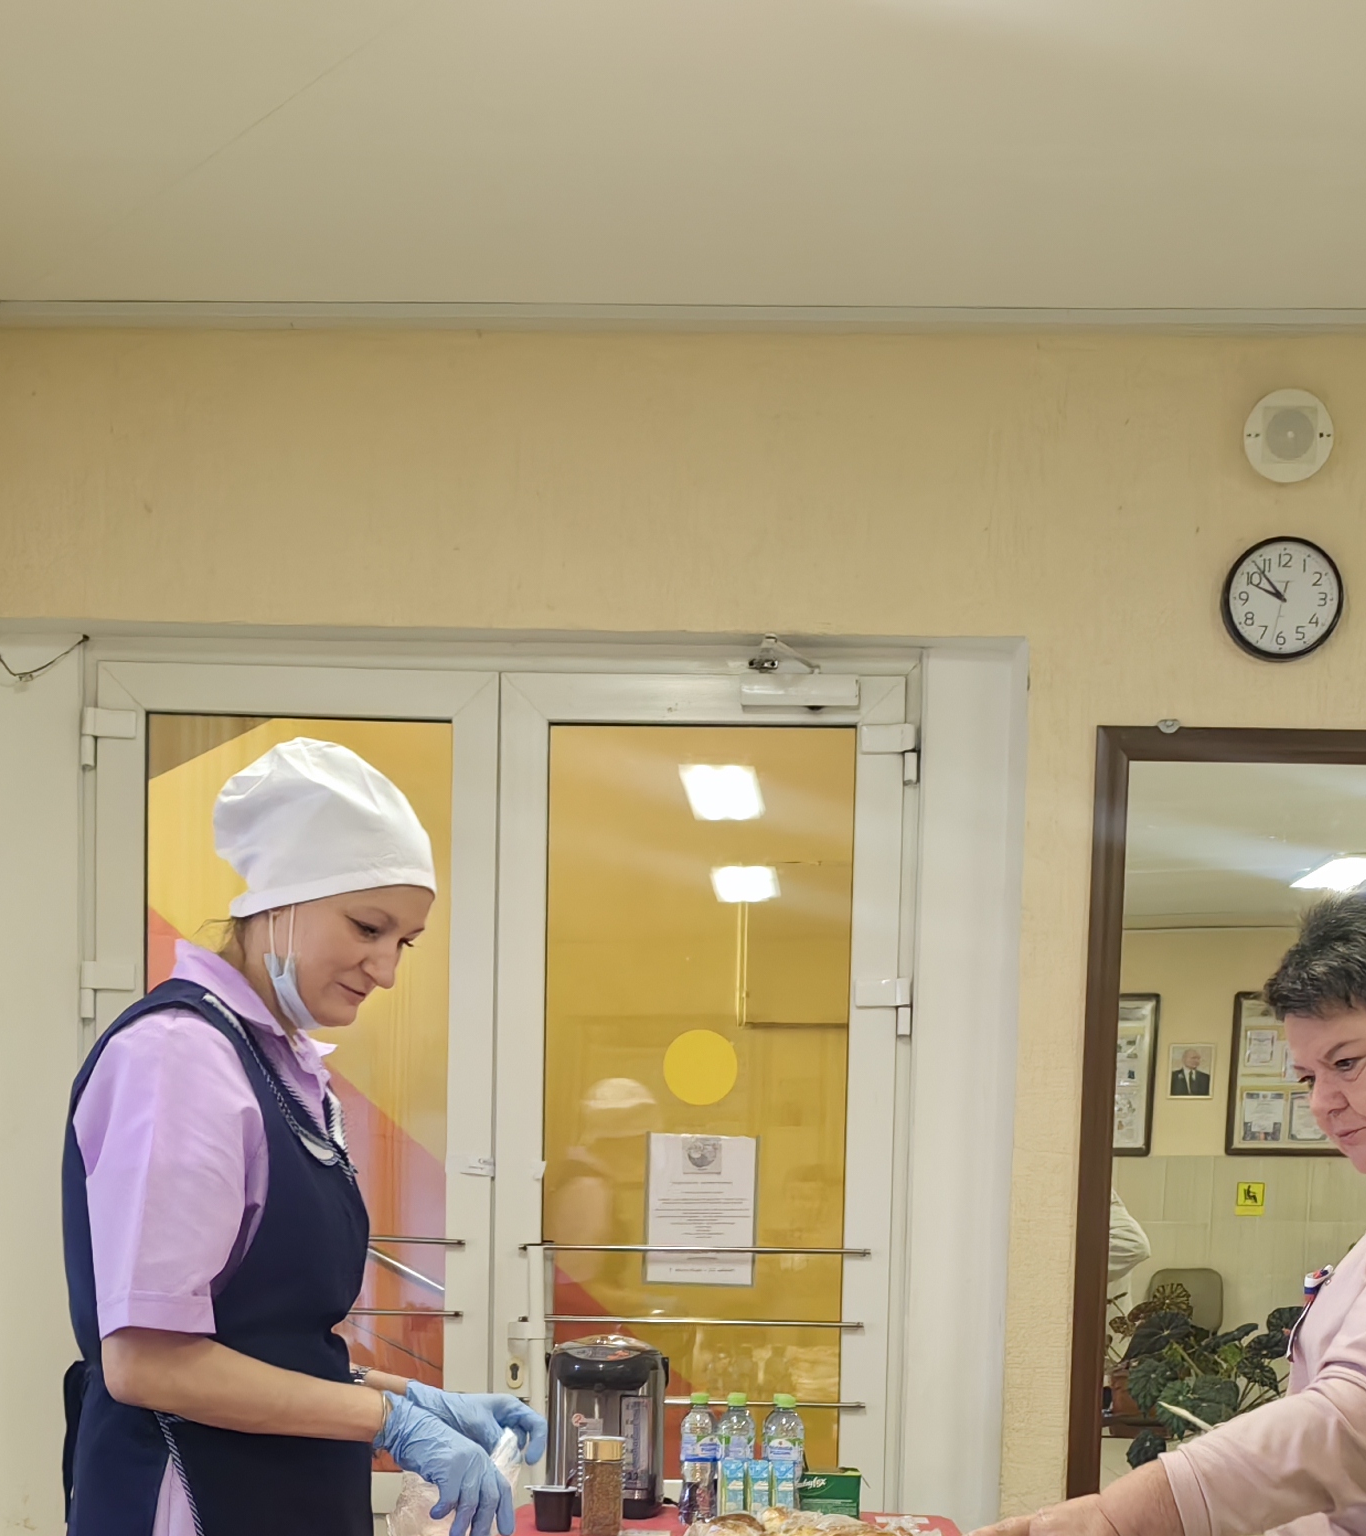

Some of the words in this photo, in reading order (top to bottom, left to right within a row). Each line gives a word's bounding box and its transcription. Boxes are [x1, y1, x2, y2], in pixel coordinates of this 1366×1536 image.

[1262, 558, 1272, 573] 11
[1278, 553, 1293, 568] 12
[1246, 572, 1262, 586] 10
[1312, 572, 1323, 586] 2
[1238, 591, 1249, 606] 9
[1317, 592, 1328, 607] 3
[1244, 611, 1254, 626] 8
[1308, 613, 1319, 627] 4
[1258, 625, 1268, 640] 7
[1275, 631, 1286, 645] 6
[1295, 626, 1305, 640] 5
